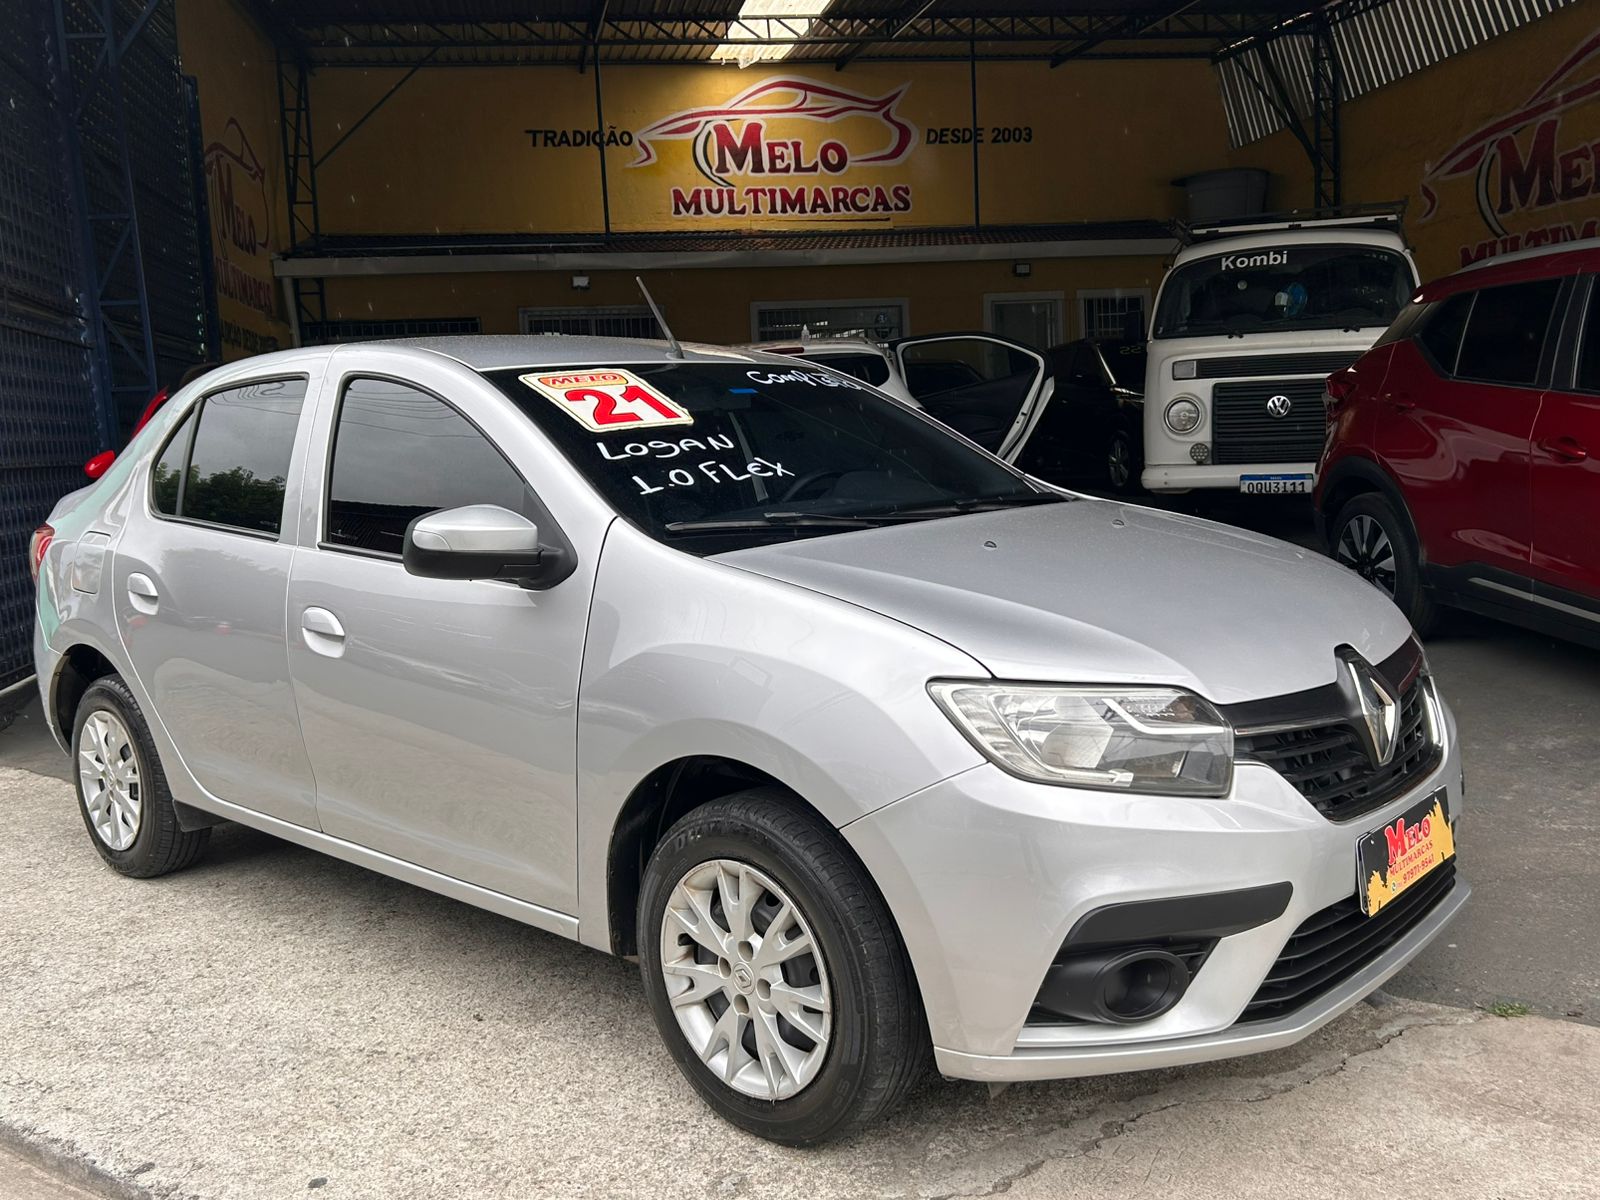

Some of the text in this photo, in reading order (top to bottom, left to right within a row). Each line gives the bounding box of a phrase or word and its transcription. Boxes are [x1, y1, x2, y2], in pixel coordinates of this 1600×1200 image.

[525, 125, 633, 149] TRADIÇÃO
[711, 120, 850, 176] MELO
[926, 126, 1033, 145] DESDE 2003
[671, 184, 912, 217] MULTIMARCAS
[1220, 250, 1288, 271] Kombi
[550, 373, 619, 386] MELO
[564, 385, 682, 425] 21
[698, 456, 796, 484] FLEX
[1384, 817, 1431, 866] MELO
[1388, 839, 1434, 876] MULTIMARCAS
